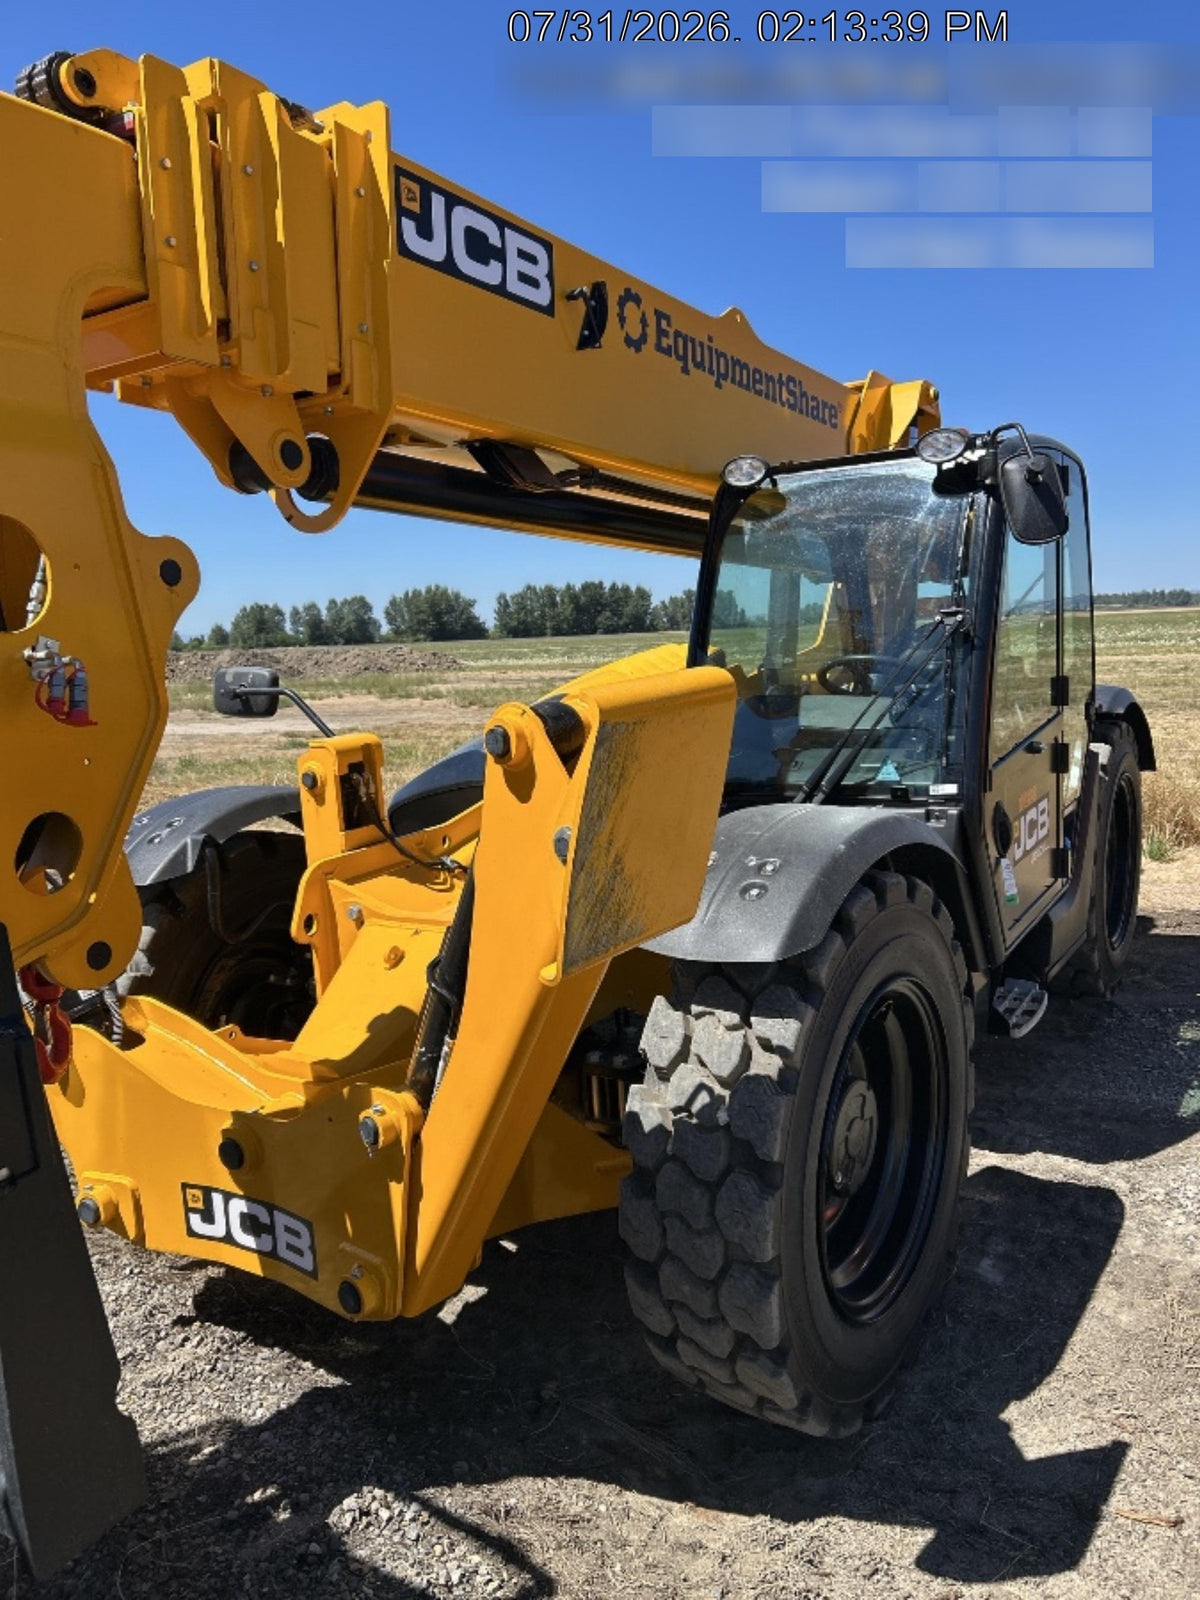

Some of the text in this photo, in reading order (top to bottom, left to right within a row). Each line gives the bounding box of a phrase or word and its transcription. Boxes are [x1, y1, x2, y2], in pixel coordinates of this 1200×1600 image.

[400, 191, 552, 308] JCB
[653, 308, 839, 430] EquipmentShare
[1014, 797, 1049, 861] JCB
[187, 1191, 314, 1273] JCB
